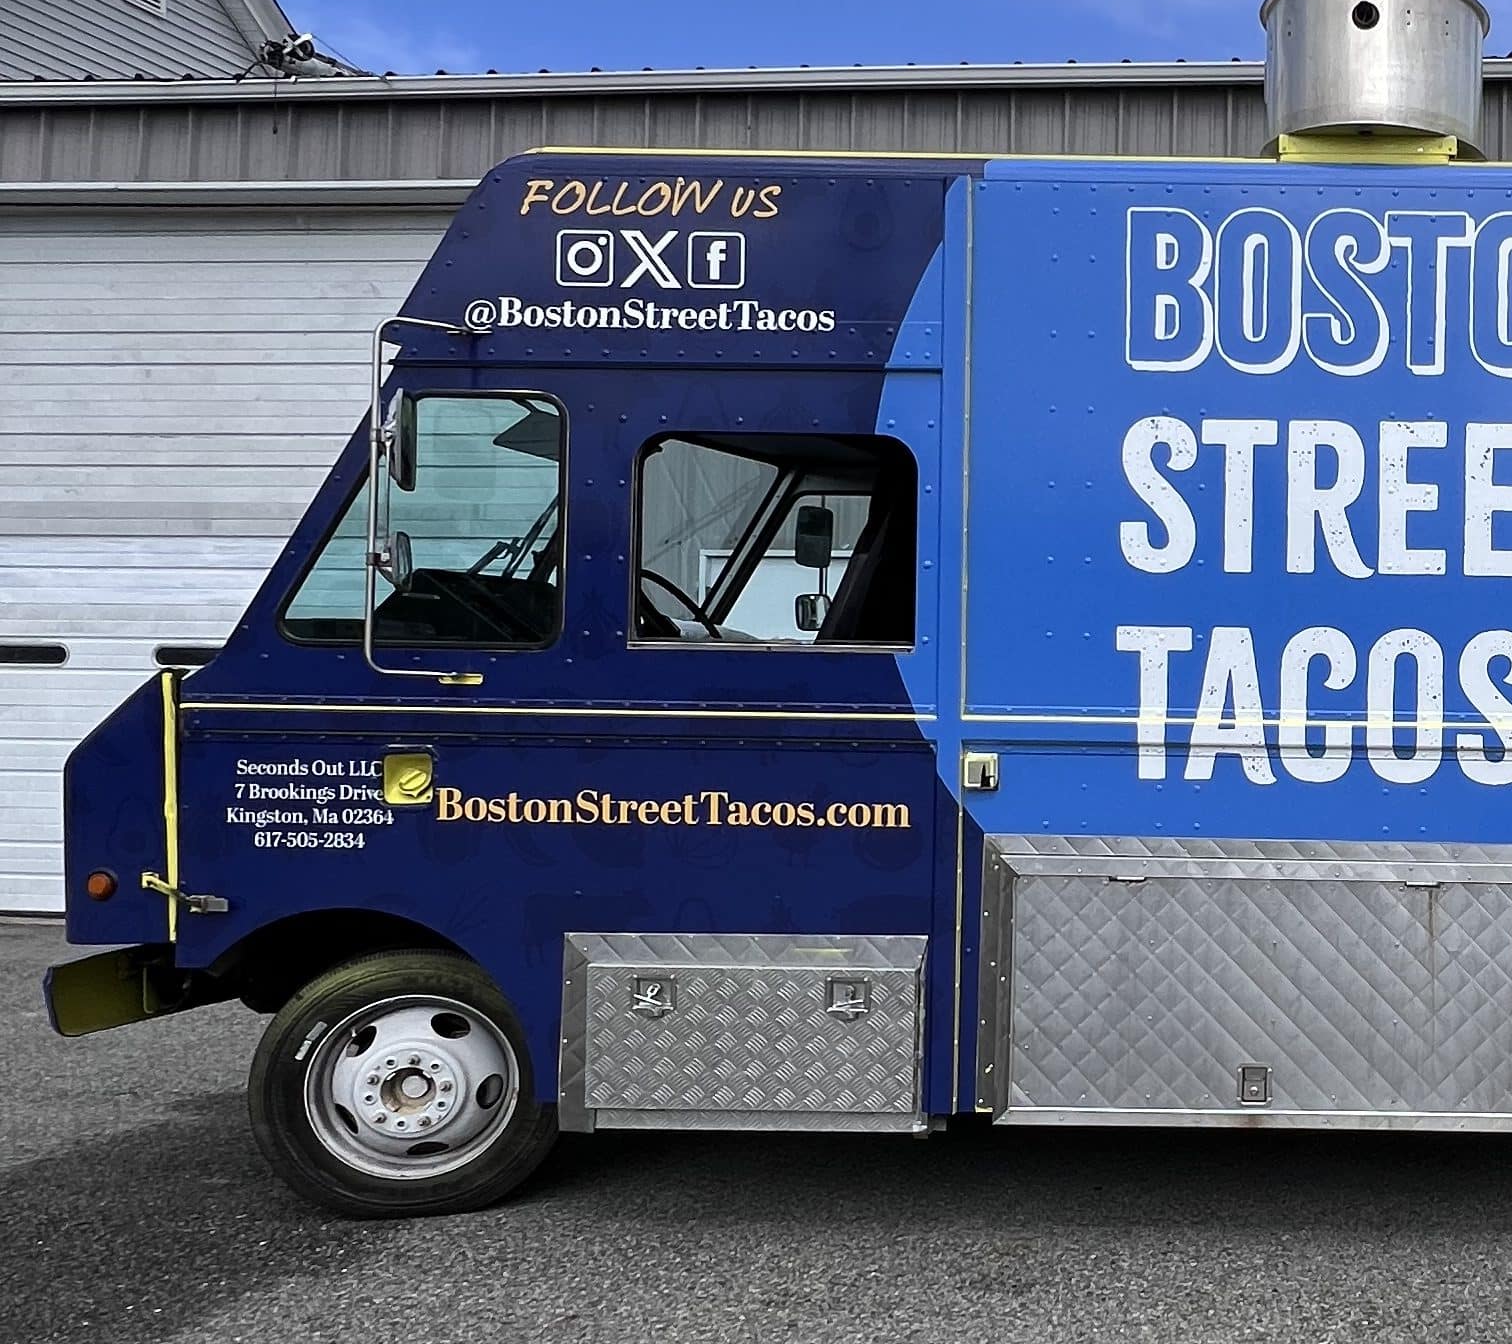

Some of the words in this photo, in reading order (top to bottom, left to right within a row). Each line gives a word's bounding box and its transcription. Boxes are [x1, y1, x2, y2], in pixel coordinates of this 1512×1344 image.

[520, 176, 724, 217] FOLLOW
[464, 296, 835, 332] @BostonStreetTacos
[236, 759, 309, 776] Seconds
[311, 759, 345, 776] Out
[349, 760, 383, 777] LLC
[234, 784, 245, 799] 7
[249, 783, 336, 804] Brookings
[339, 784, 384, 801] Drive
[226, 807, 308, 827] Kingston,
[312, 808, 339, 824] Ma
[342, 808, 394, 825] 02364
[435, 787, 911, 828] BostonStreetTacos.com
[254, 832, 366, 849] 617-505-2834
